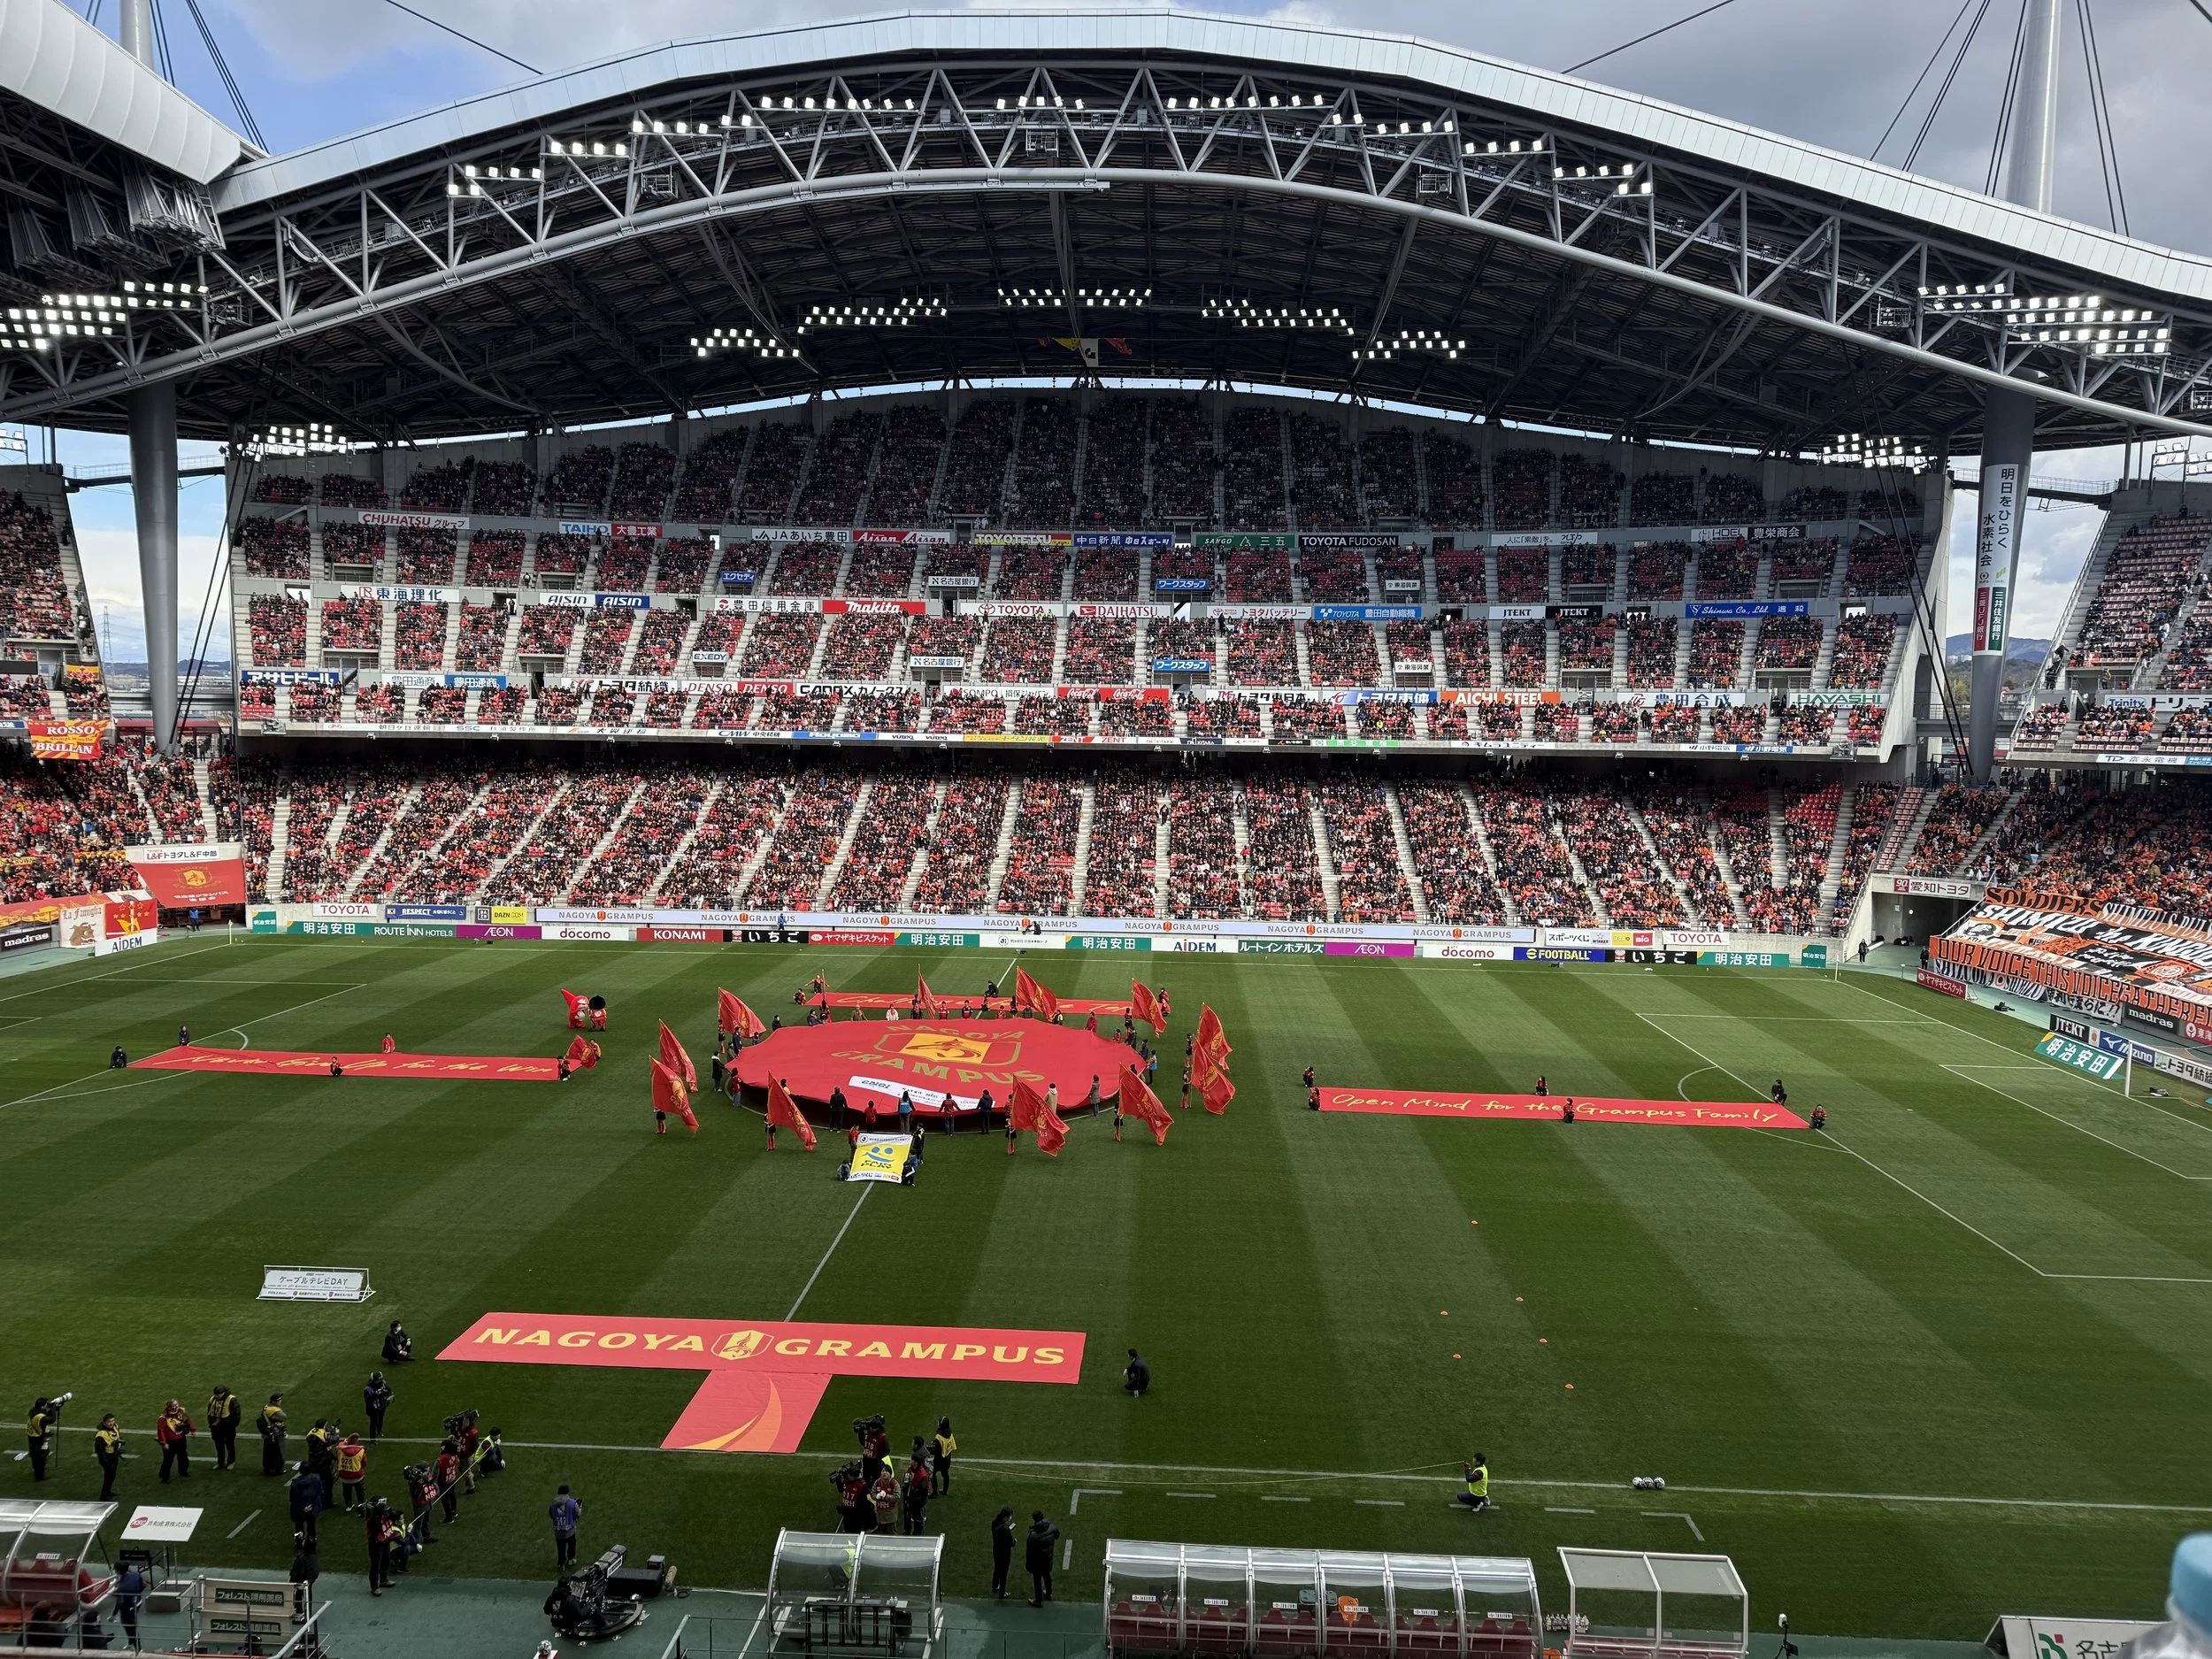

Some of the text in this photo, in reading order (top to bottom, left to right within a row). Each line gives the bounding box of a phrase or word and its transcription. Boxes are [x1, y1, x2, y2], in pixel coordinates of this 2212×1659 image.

[1997, 467, 2016, 549] 明日をひらく
[362, 513, 465, 528] CHUHATSU グループ
[562, 523, 609, 534] TAIHO
[616, 525, 658, 536] 大豊工業
[858, 532, 896, 542] Aisan
[908, 533, 946, 543] Aisan
[977, 534, 1051, 545] TOYOTETSU
[1077, 535, 1120, 545] 中日新聞
[1125, 536, 1170, 545] 中日スポーツ
[1260, 536, 1286, 547] 三五
[1302, 537, 1396, 546] TOYOTA FUDOSAN
[1980, 513, 1996, 566] 水素社会
[723, 572, 754, 581] エクセディ
[940, 577, 976, 587] 名古屋銀行
[1158, 579, 1207, 588] ワークスタッフ
[376, 588, 442, 600] 東海理化
[549, 595, 588, 605] AISIN
[604, 596, 641, 607] AISIN
[733, 599, 815, 611] 豊田信用金庫
[998, 604, 1045, 614] TOYOTA
[1099, 605, 1157, 617] DAIHATSU
[1241, 608, 1306, 617] トヨタバッテリー
[1333, 610, 1359, 618] TOYOTA
[1503, 609, 1532, 618] JTEKT
[1701, 606, 1733, 615] Shinwa
[1976, 591, 1986, 641] 三菱UFJ銀行
[1991, 591, 2004, 641] 三井住友銀行
[922, 657, 963, 666] 名古屋銀行
[1156, 661, 1207, 671] ワークスタッフ
[247, 672, 334, 686] アサヒビール
[454, 677, 499, 688] 豊田通商
[599, 680, 669, 692] トヨタ紡織
[687, 682, 733, 693] DENSO
[743, 684, 787, 694] DENSO
[964, 689, 998, 698] SOMPO
[1455, 692, 1545, 705] AICHI STEEL
[1797, 695, 1881, 703] HAYASHI
[47, 726, 95, 735] ROSSO
[35, 742, 94, 754] BRILLAN
[164, 850, 218, 859] トヨタL&F中部
[1909, 880, 1969, 896] 愛知トヨタ
[1987, 887, 2103, 917] SOLDIERS
[321, 904, 370, 915] TOYOTA
[558, 911, 654, 921] NAGOYA GRAMPUS
[1974, 904, 2102, 934] SHIMIZU
[2101, 902, 2168, 931] SHIMIZU
[303, 922, 356, 935] 明治安田
[374, 926, 453, 938] ROUTE HOTELS
[559, 927, 611, 940] docomo
[1316, 926, 1364, 935] GRAMPUS
[4, 932, 50, 948] madras
[654, 930, 706, 941] KONAMI
[749, 932, 800, 943] いちご
[825, 933, 889, 943] ヤマザキビスケット
[910, 933, 964, 946] 明治安田
[1548, 933, 1590, 942] スポーツくじ
[1671, 933, 1722, 943] TOYOTA
[1082, 937, 1135, 949] 明治安田
[1240, 941, 1325, 954] ルートイン ホテルズ
[1441, 946, 1494, 958] docomo
[1632, 951, 1687, 964] いちご
[1715, 953, 1772, 966] 明治安田
[1938, 939, 2123, 1005] OUR VOICE THIS VOICE
[1925, 972, 1963, 995] ヤマザキビスケット
[2129, 1008, 2174, 1029] madras
[886, 1025, 1025, 1040] NAGOYA
[2055, 1017, 2085, 1038] JTEKT
[2046, 1038, 2109, 1074] 明治安田
[2118, 1042, 2153, 1063] MZUNO
[830, 1050, 1046, 1084] GRAMPUS
[1333, 1093, 1779, 1125] Open Mind for the Grampus Family
[279, 1276, 349, 1286] ケーブルテレビDAY
[472, 1328, 704, 1352] NAGOYA
[774, 1339, 1064, 1364] GRAMPUS
[2076, 1640, 2131, 1659] 名古
